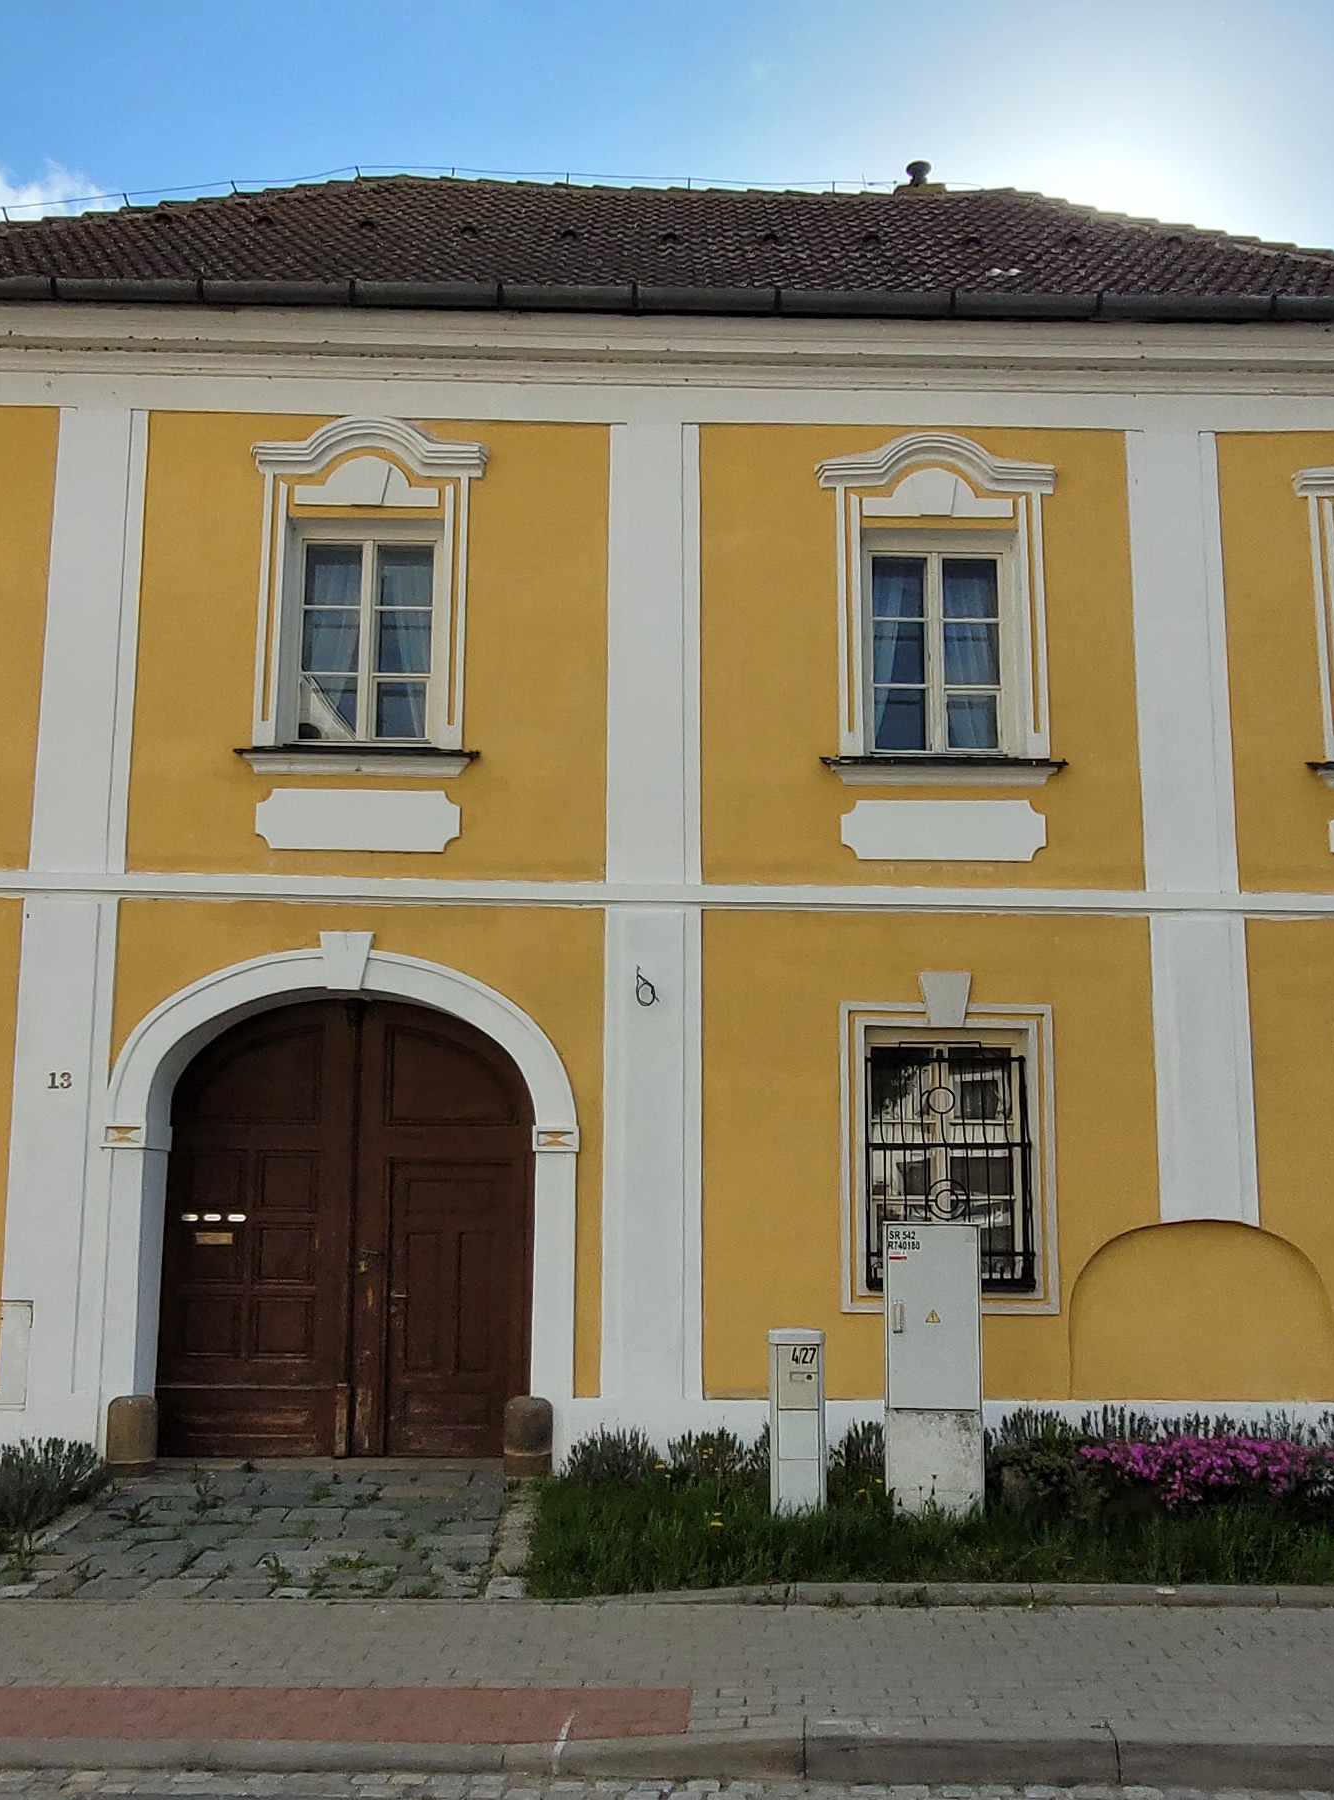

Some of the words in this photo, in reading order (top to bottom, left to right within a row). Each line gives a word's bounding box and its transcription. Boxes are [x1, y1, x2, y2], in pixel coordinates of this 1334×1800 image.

[47, 1072, 72, 1089] 13
[889, 1230, 901, 1240] SR
[902, 1230, 916, 1240] 542
